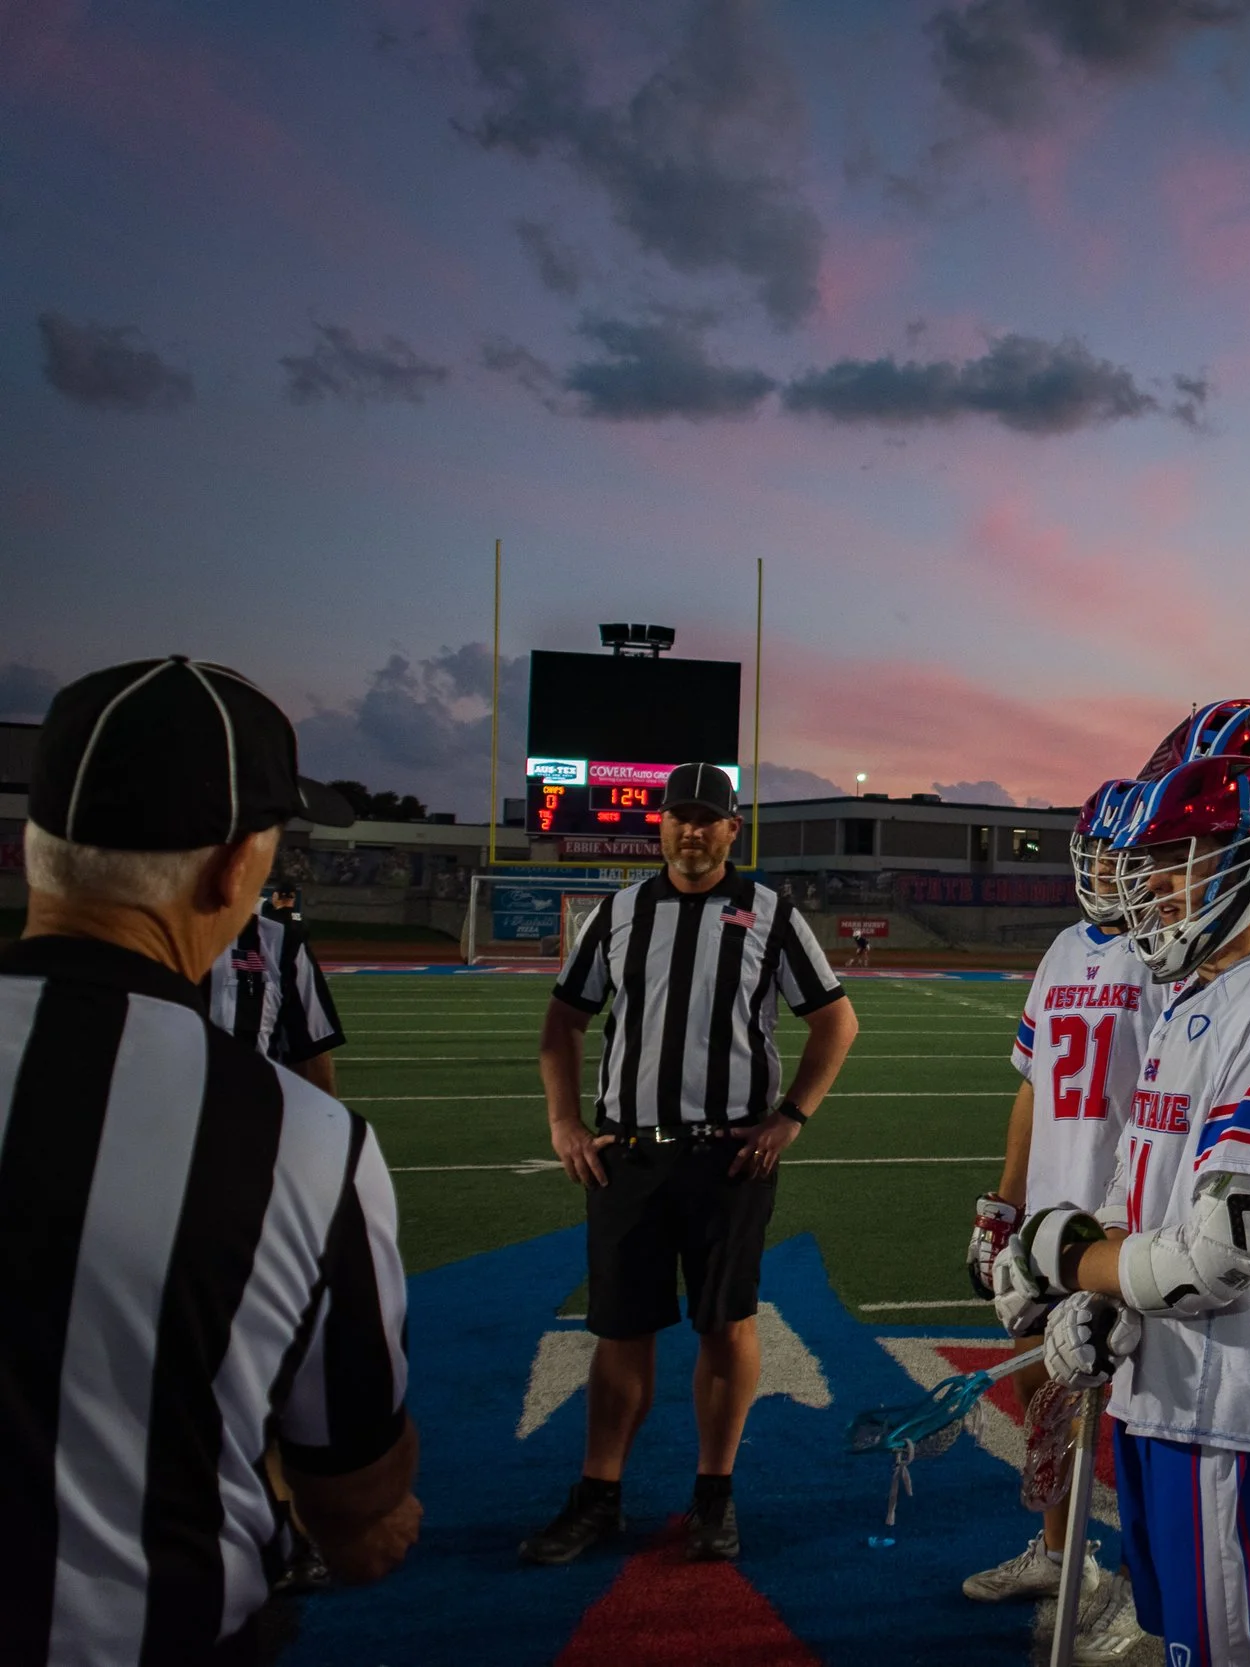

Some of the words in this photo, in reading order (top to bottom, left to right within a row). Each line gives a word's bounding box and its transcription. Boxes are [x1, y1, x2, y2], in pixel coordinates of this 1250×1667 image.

[589, 765, 634, 778] COVERT
[633, 770, 652, 780] AUTO
[653, 771, 672, 780] GRO
[566, 842, 601, 853] EBBIE
[603, 842, 660, 856] NEPTUNE
[1049, 1013, 1117, 1121] 21
